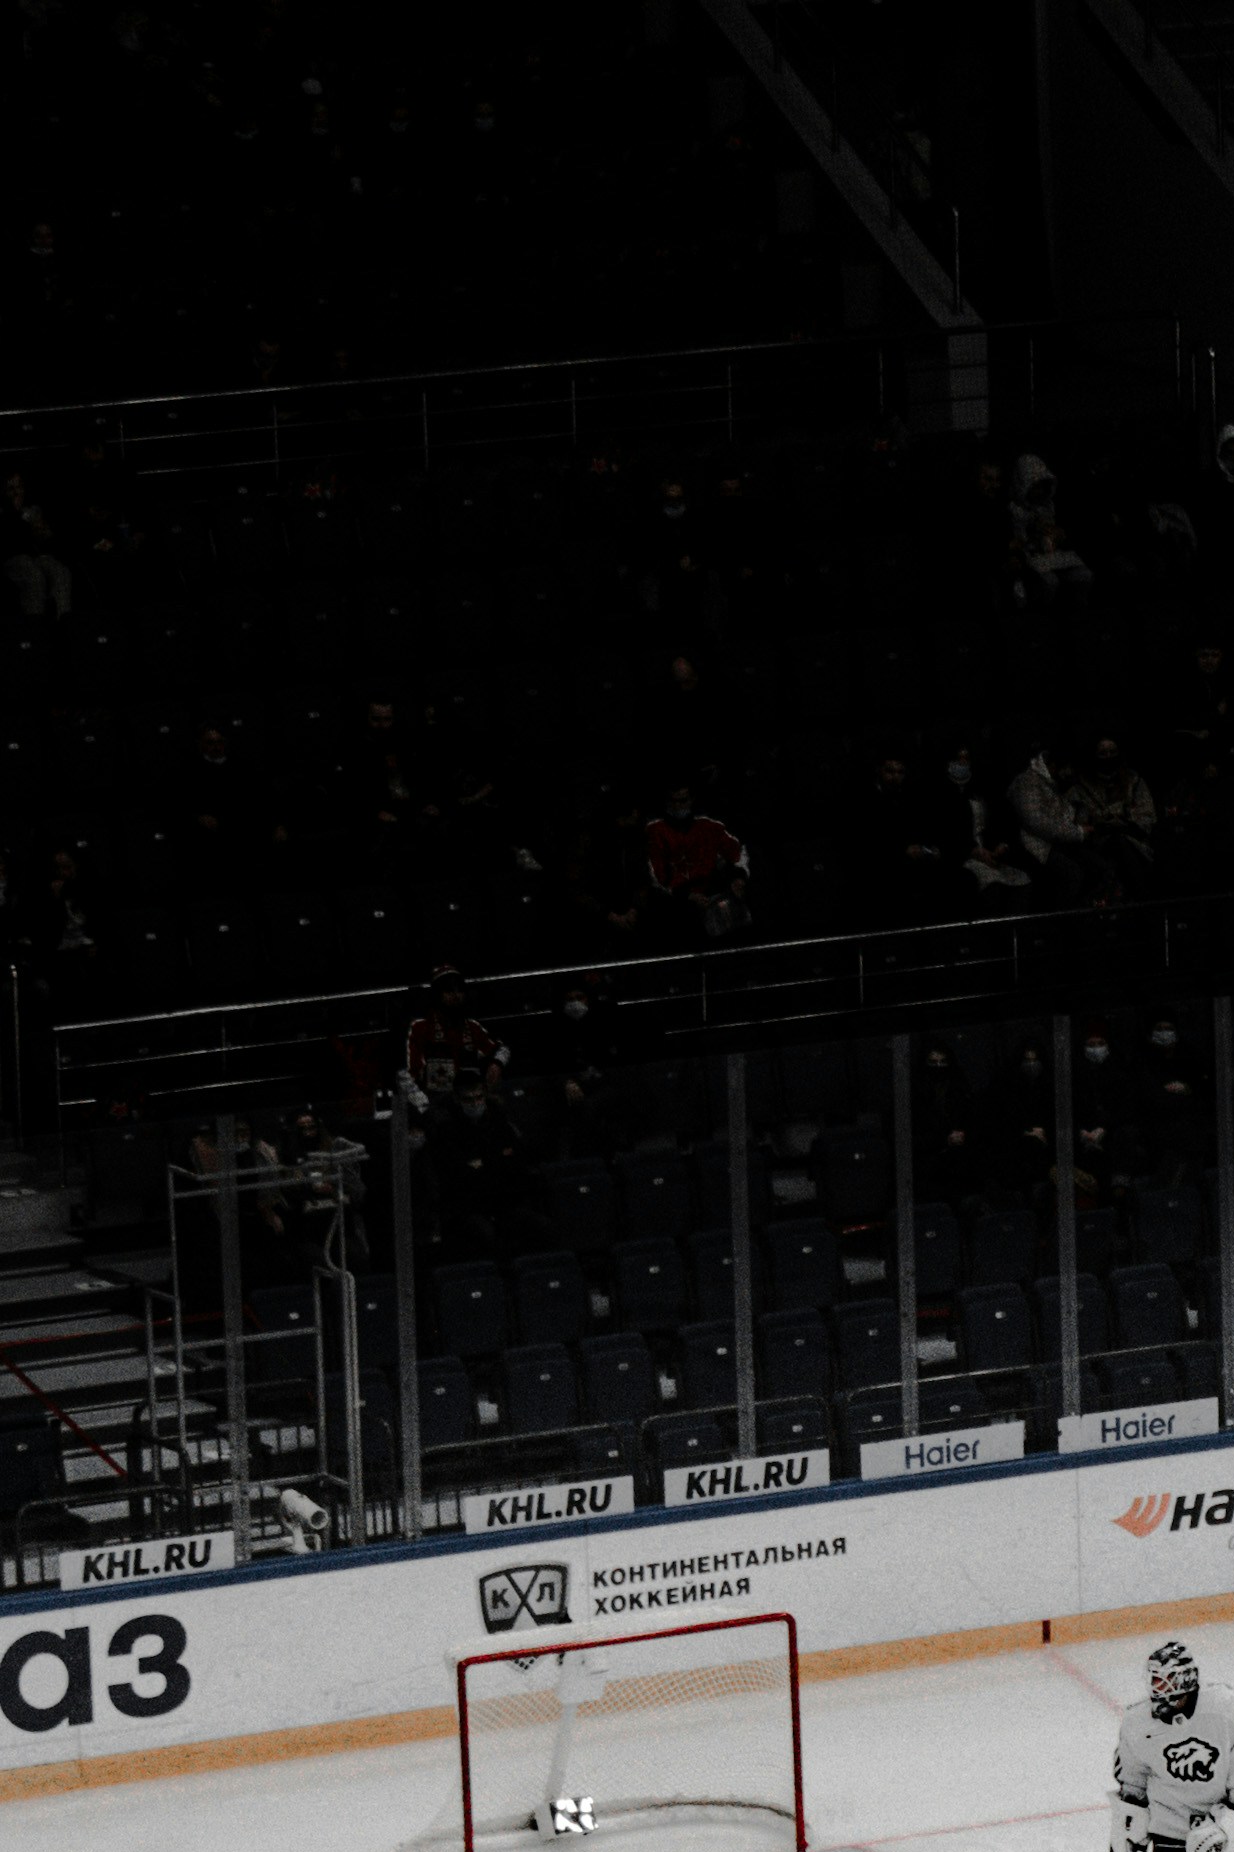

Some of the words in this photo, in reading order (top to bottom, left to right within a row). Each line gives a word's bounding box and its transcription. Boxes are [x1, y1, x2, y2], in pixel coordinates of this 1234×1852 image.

[1100, 1413, 1176, 1444] Haier
[904, 1438, 980, 1470] Haier
[685, 1456, 810, 1501] KHL.RU
[486, 1482, 613, 1528] KHL.RU
[81, 1538, 213, 1585] KHL.RU
[593, 1537, 847, 1588] КОНТИНЕНТАЛЬНАЯ
[594, 1577, 751, 1616] ХОККЕЙНАЯ
